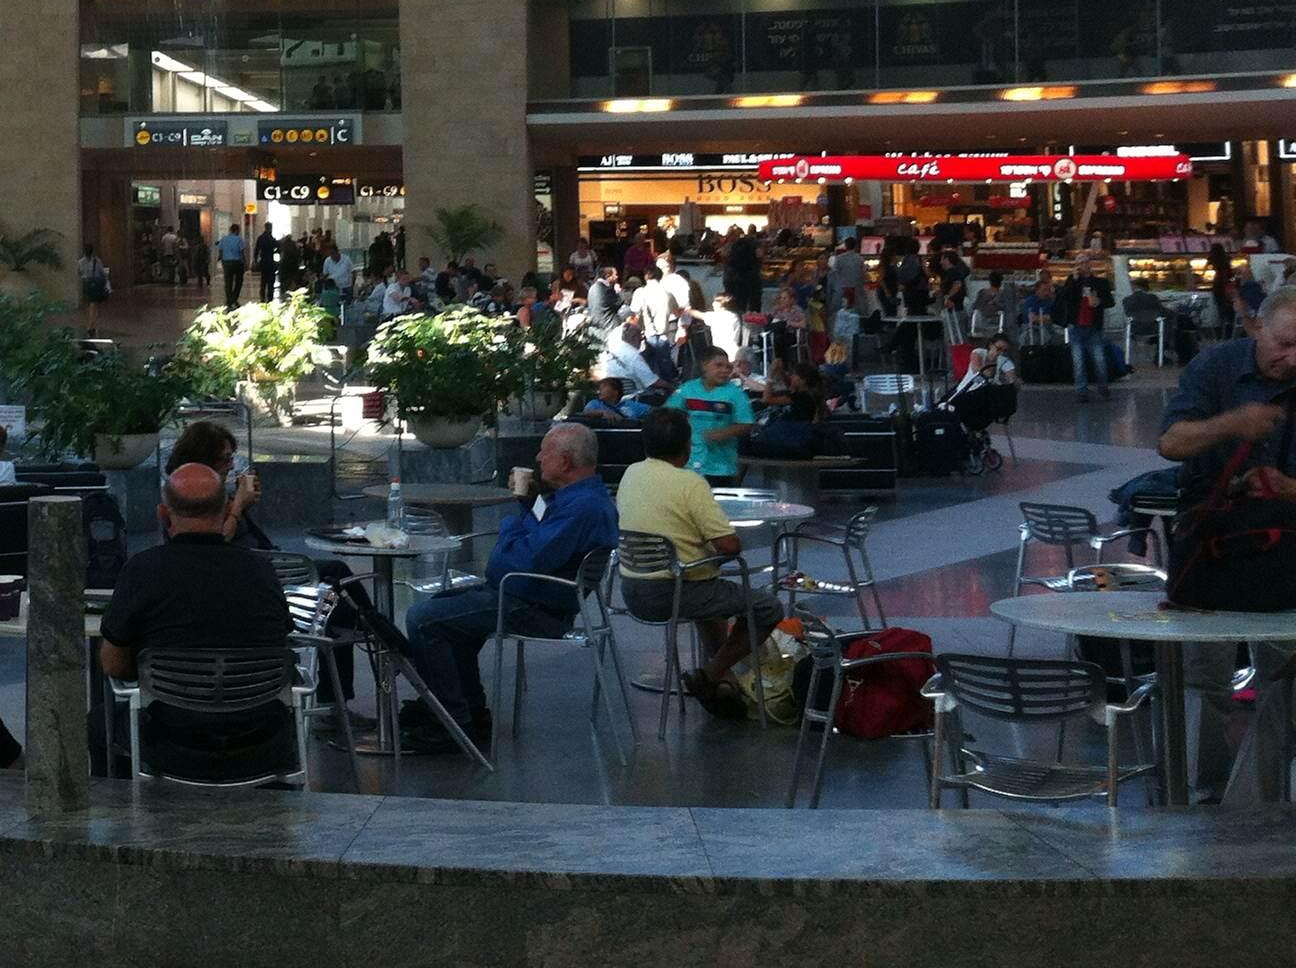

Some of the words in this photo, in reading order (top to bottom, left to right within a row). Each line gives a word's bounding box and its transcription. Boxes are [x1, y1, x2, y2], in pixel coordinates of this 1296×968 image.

[336, 129, 348, 142] C
[897, 161, 940, 176] café
[697, 173, 771, 194] BOSS
